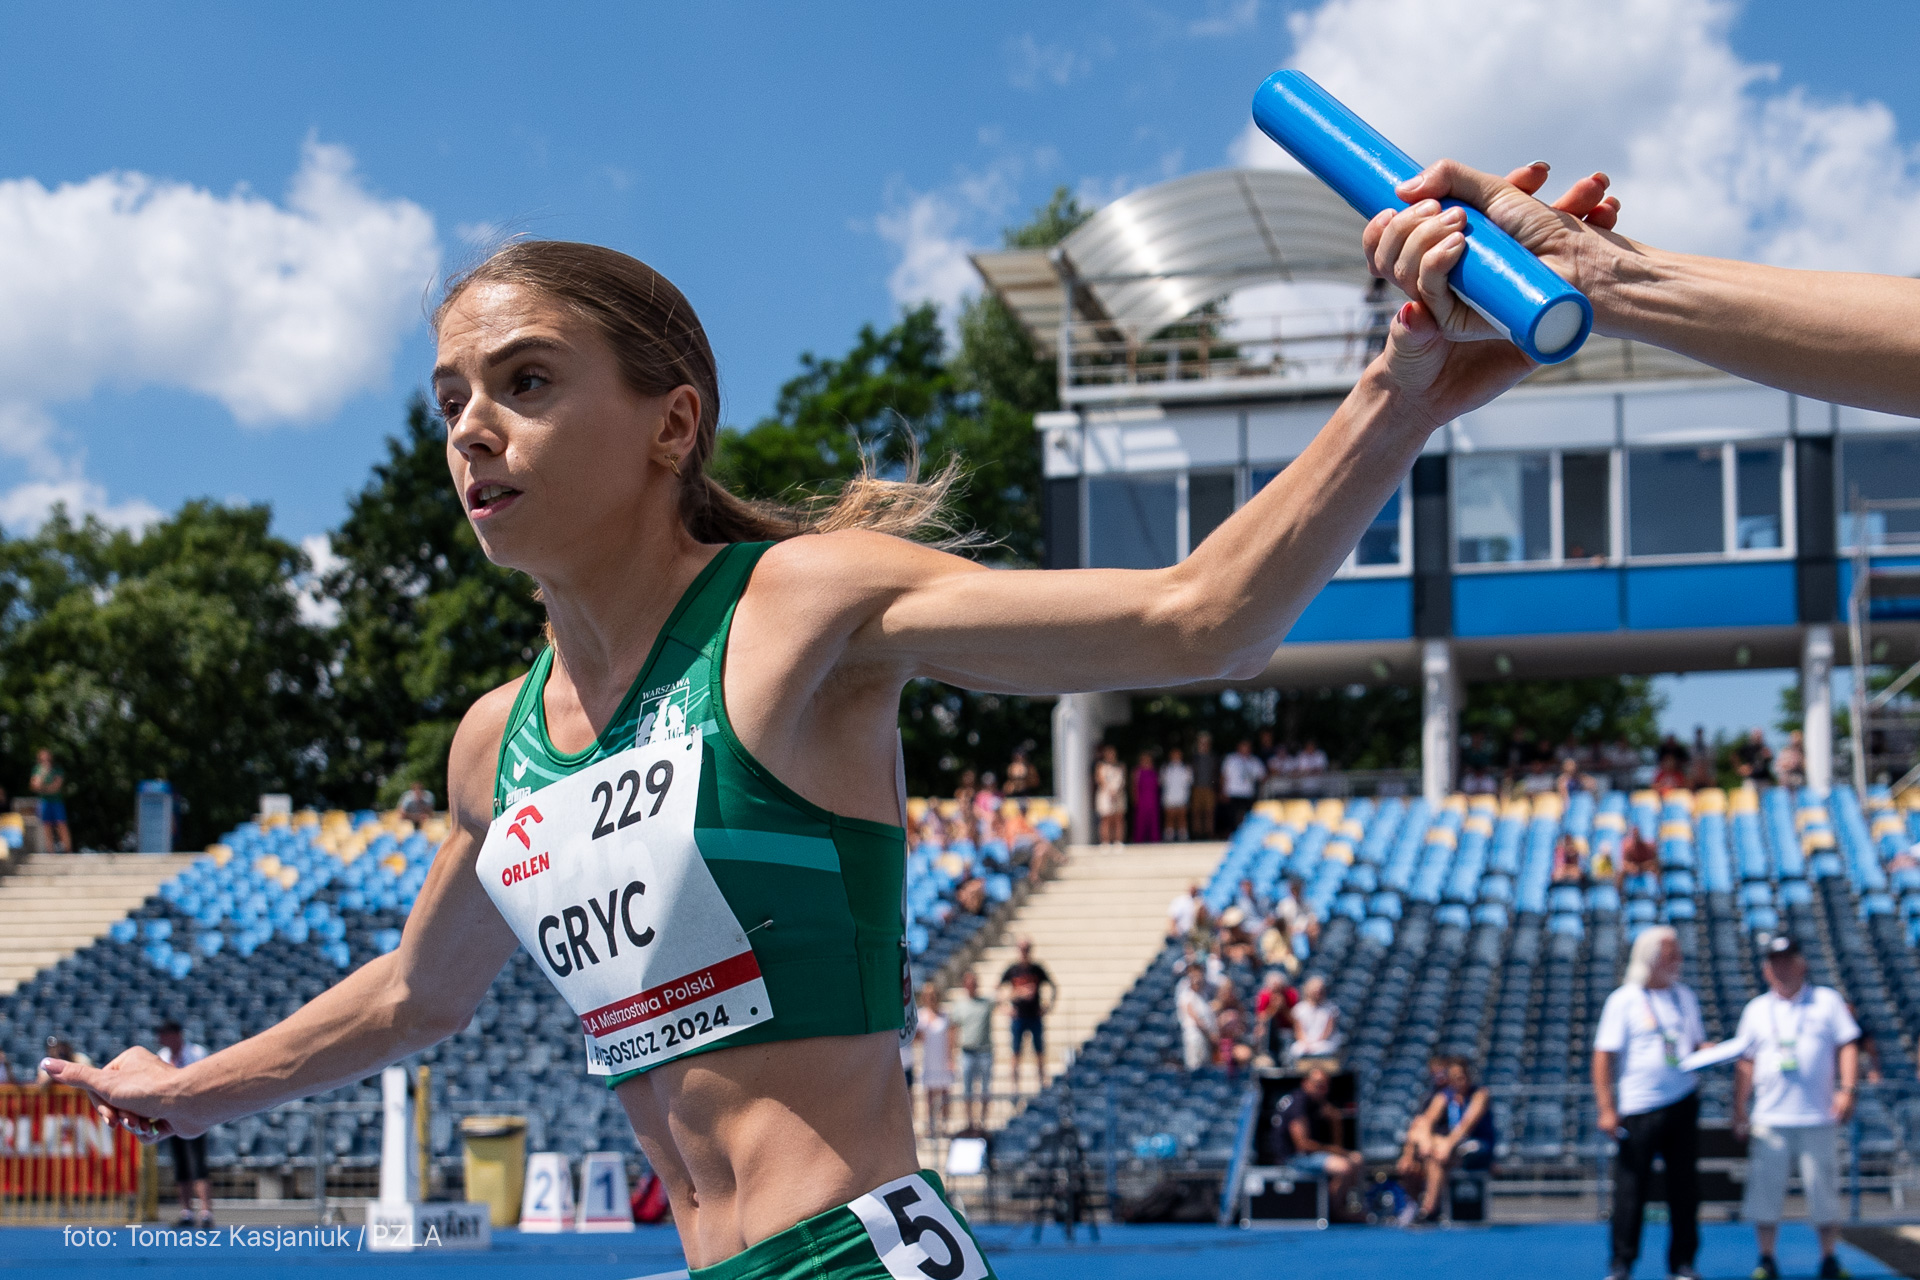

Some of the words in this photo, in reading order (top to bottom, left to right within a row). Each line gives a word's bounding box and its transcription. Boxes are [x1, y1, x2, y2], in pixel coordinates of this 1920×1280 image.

[642, 677, 690, 700] WARSZAWA
[592, 760, 674, 840] 229
[501, 852, 550, 886] ORLEN
[538, 880, 656, 978] GRYC
[597, 997, 661, 1030] Mistrzostwa
[663, 972, 716, 1006] Polski
[660, 1004, 730, 1048] 2024
[535, 1170, 553, 1212] 2
[593, 1168, 615, 1212] 1
[883, 1185, 965, 1280] 5
